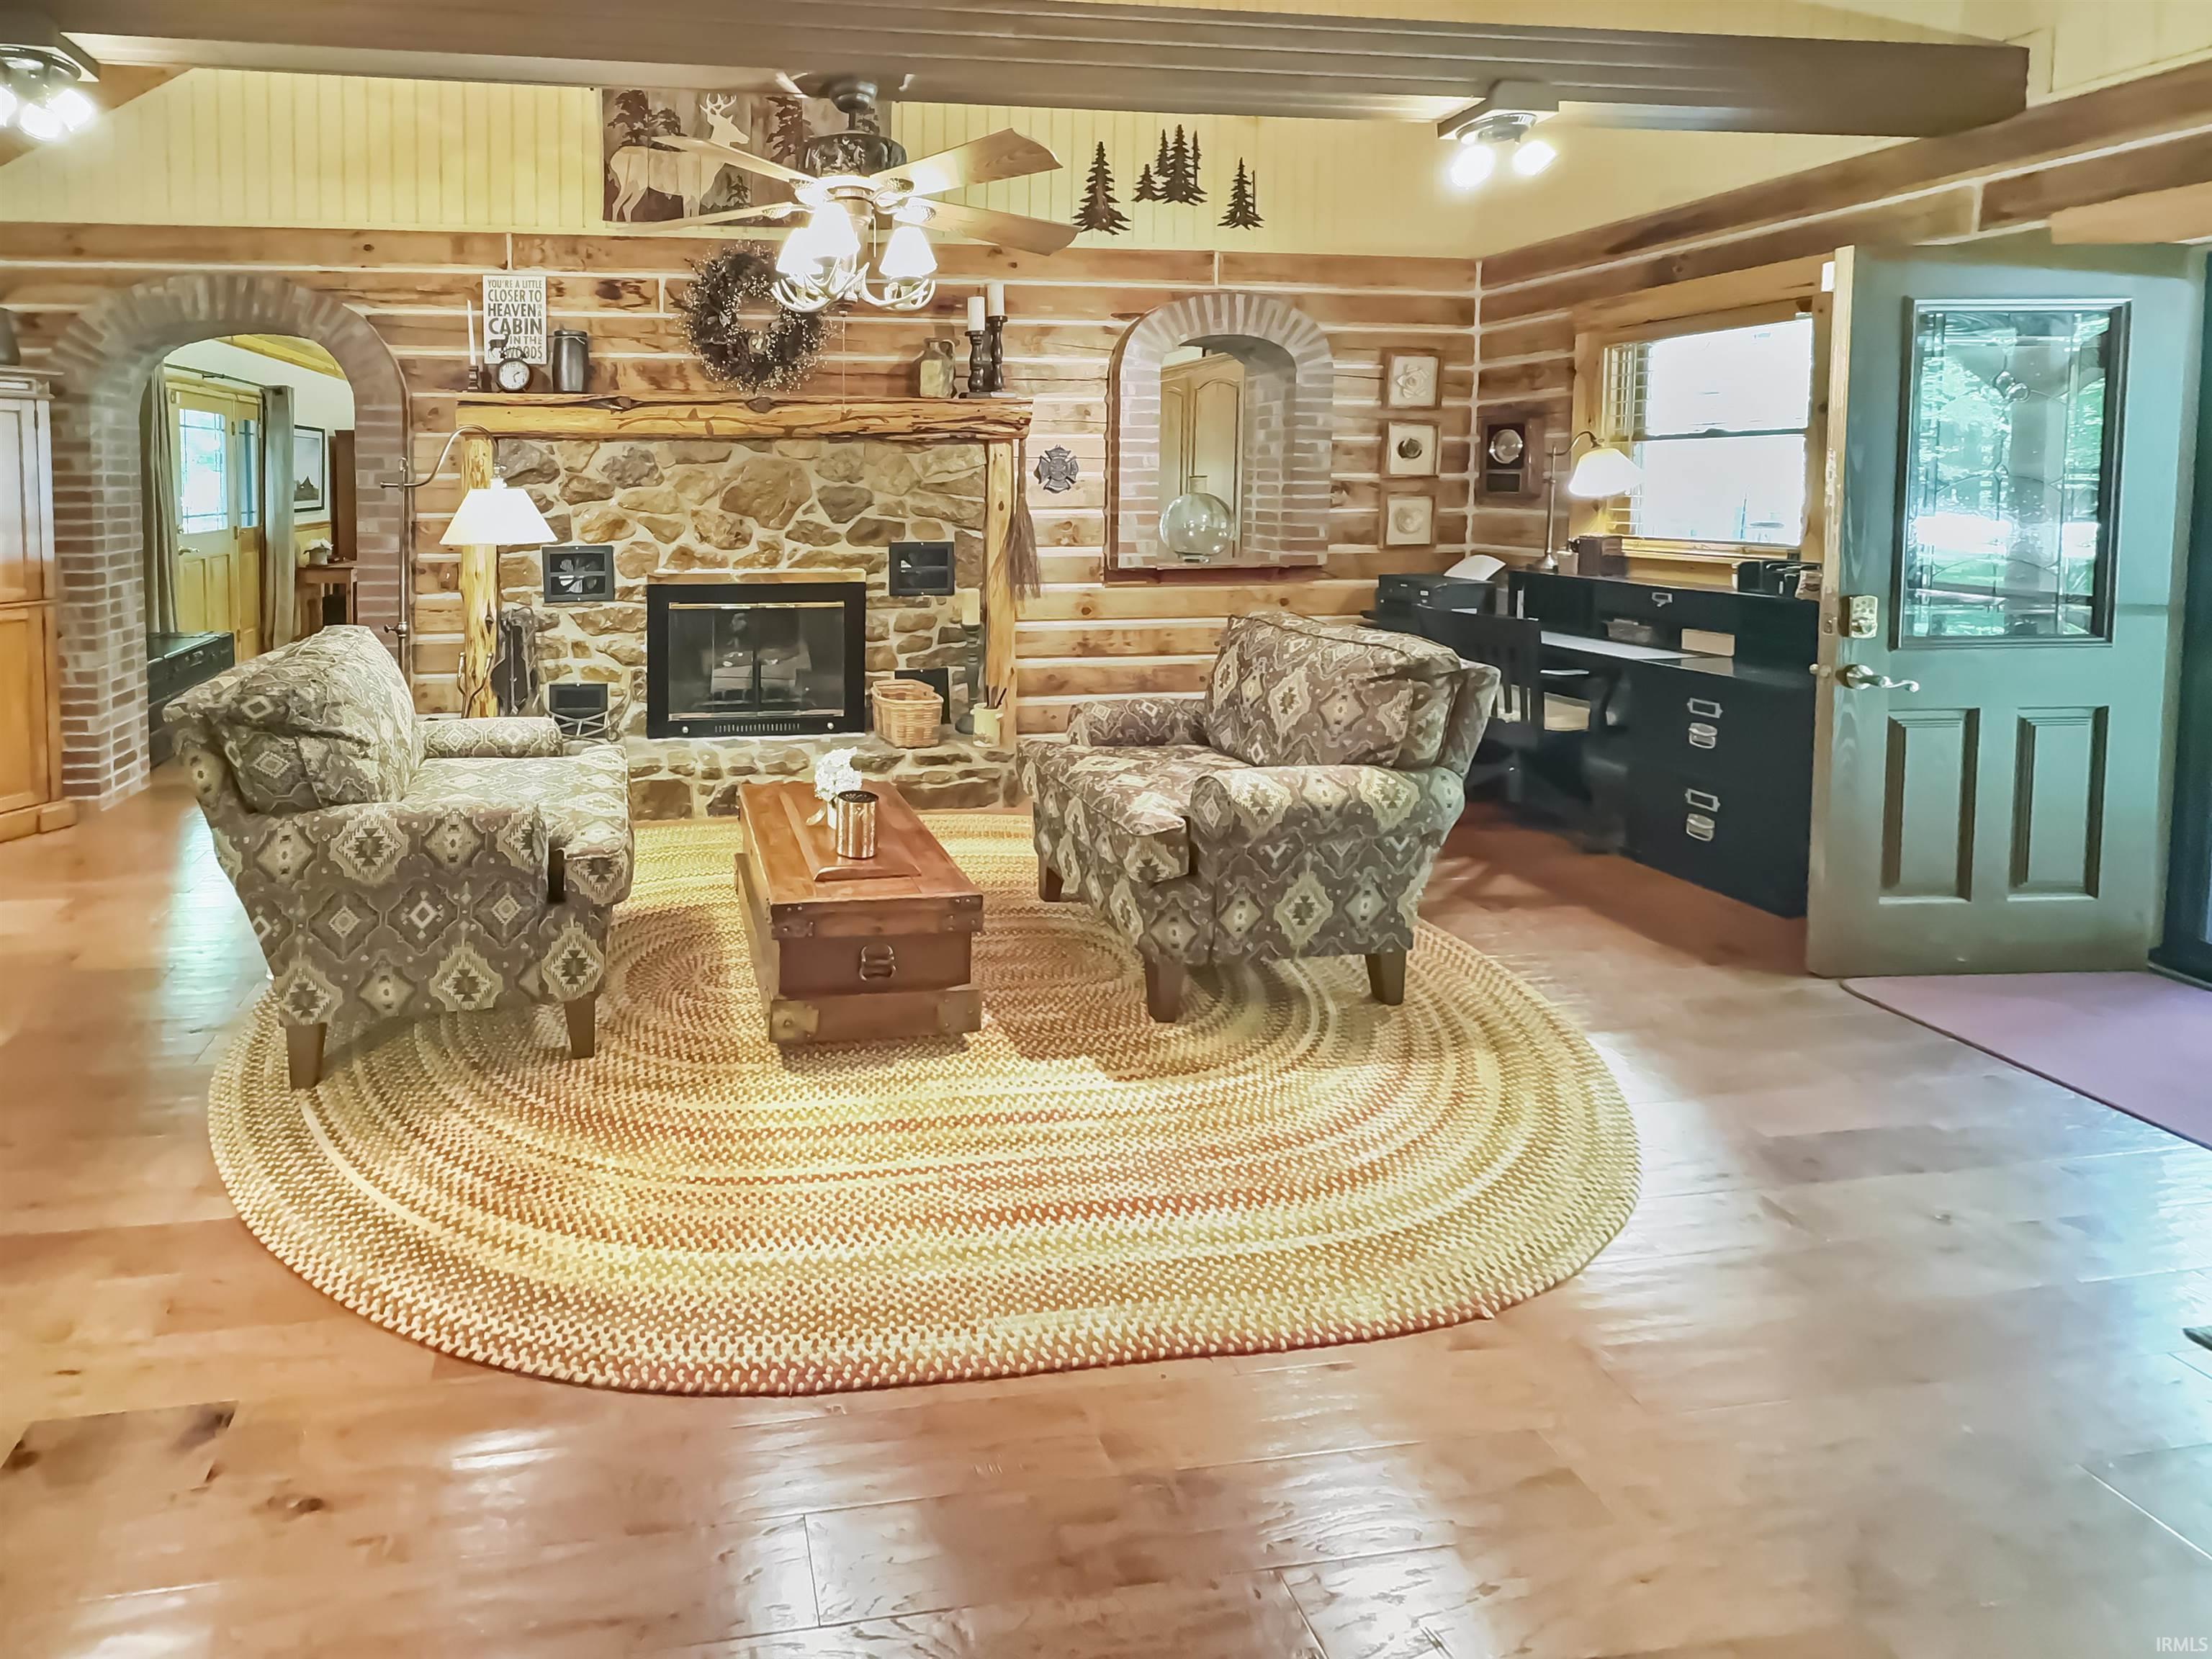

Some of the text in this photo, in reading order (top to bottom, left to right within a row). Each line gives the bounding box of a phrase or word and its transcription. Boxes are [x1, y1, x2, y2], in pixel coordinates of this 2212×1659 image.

[487, 279, 542, 289] YOU'RE A LITTLE
[487, 289, 542, 302] CLOSER TO
[487, 303, 536, 317] HEAVEN
[488, 318, 542, 335] CABIN
[510, 336, 542, 345] IN THE
